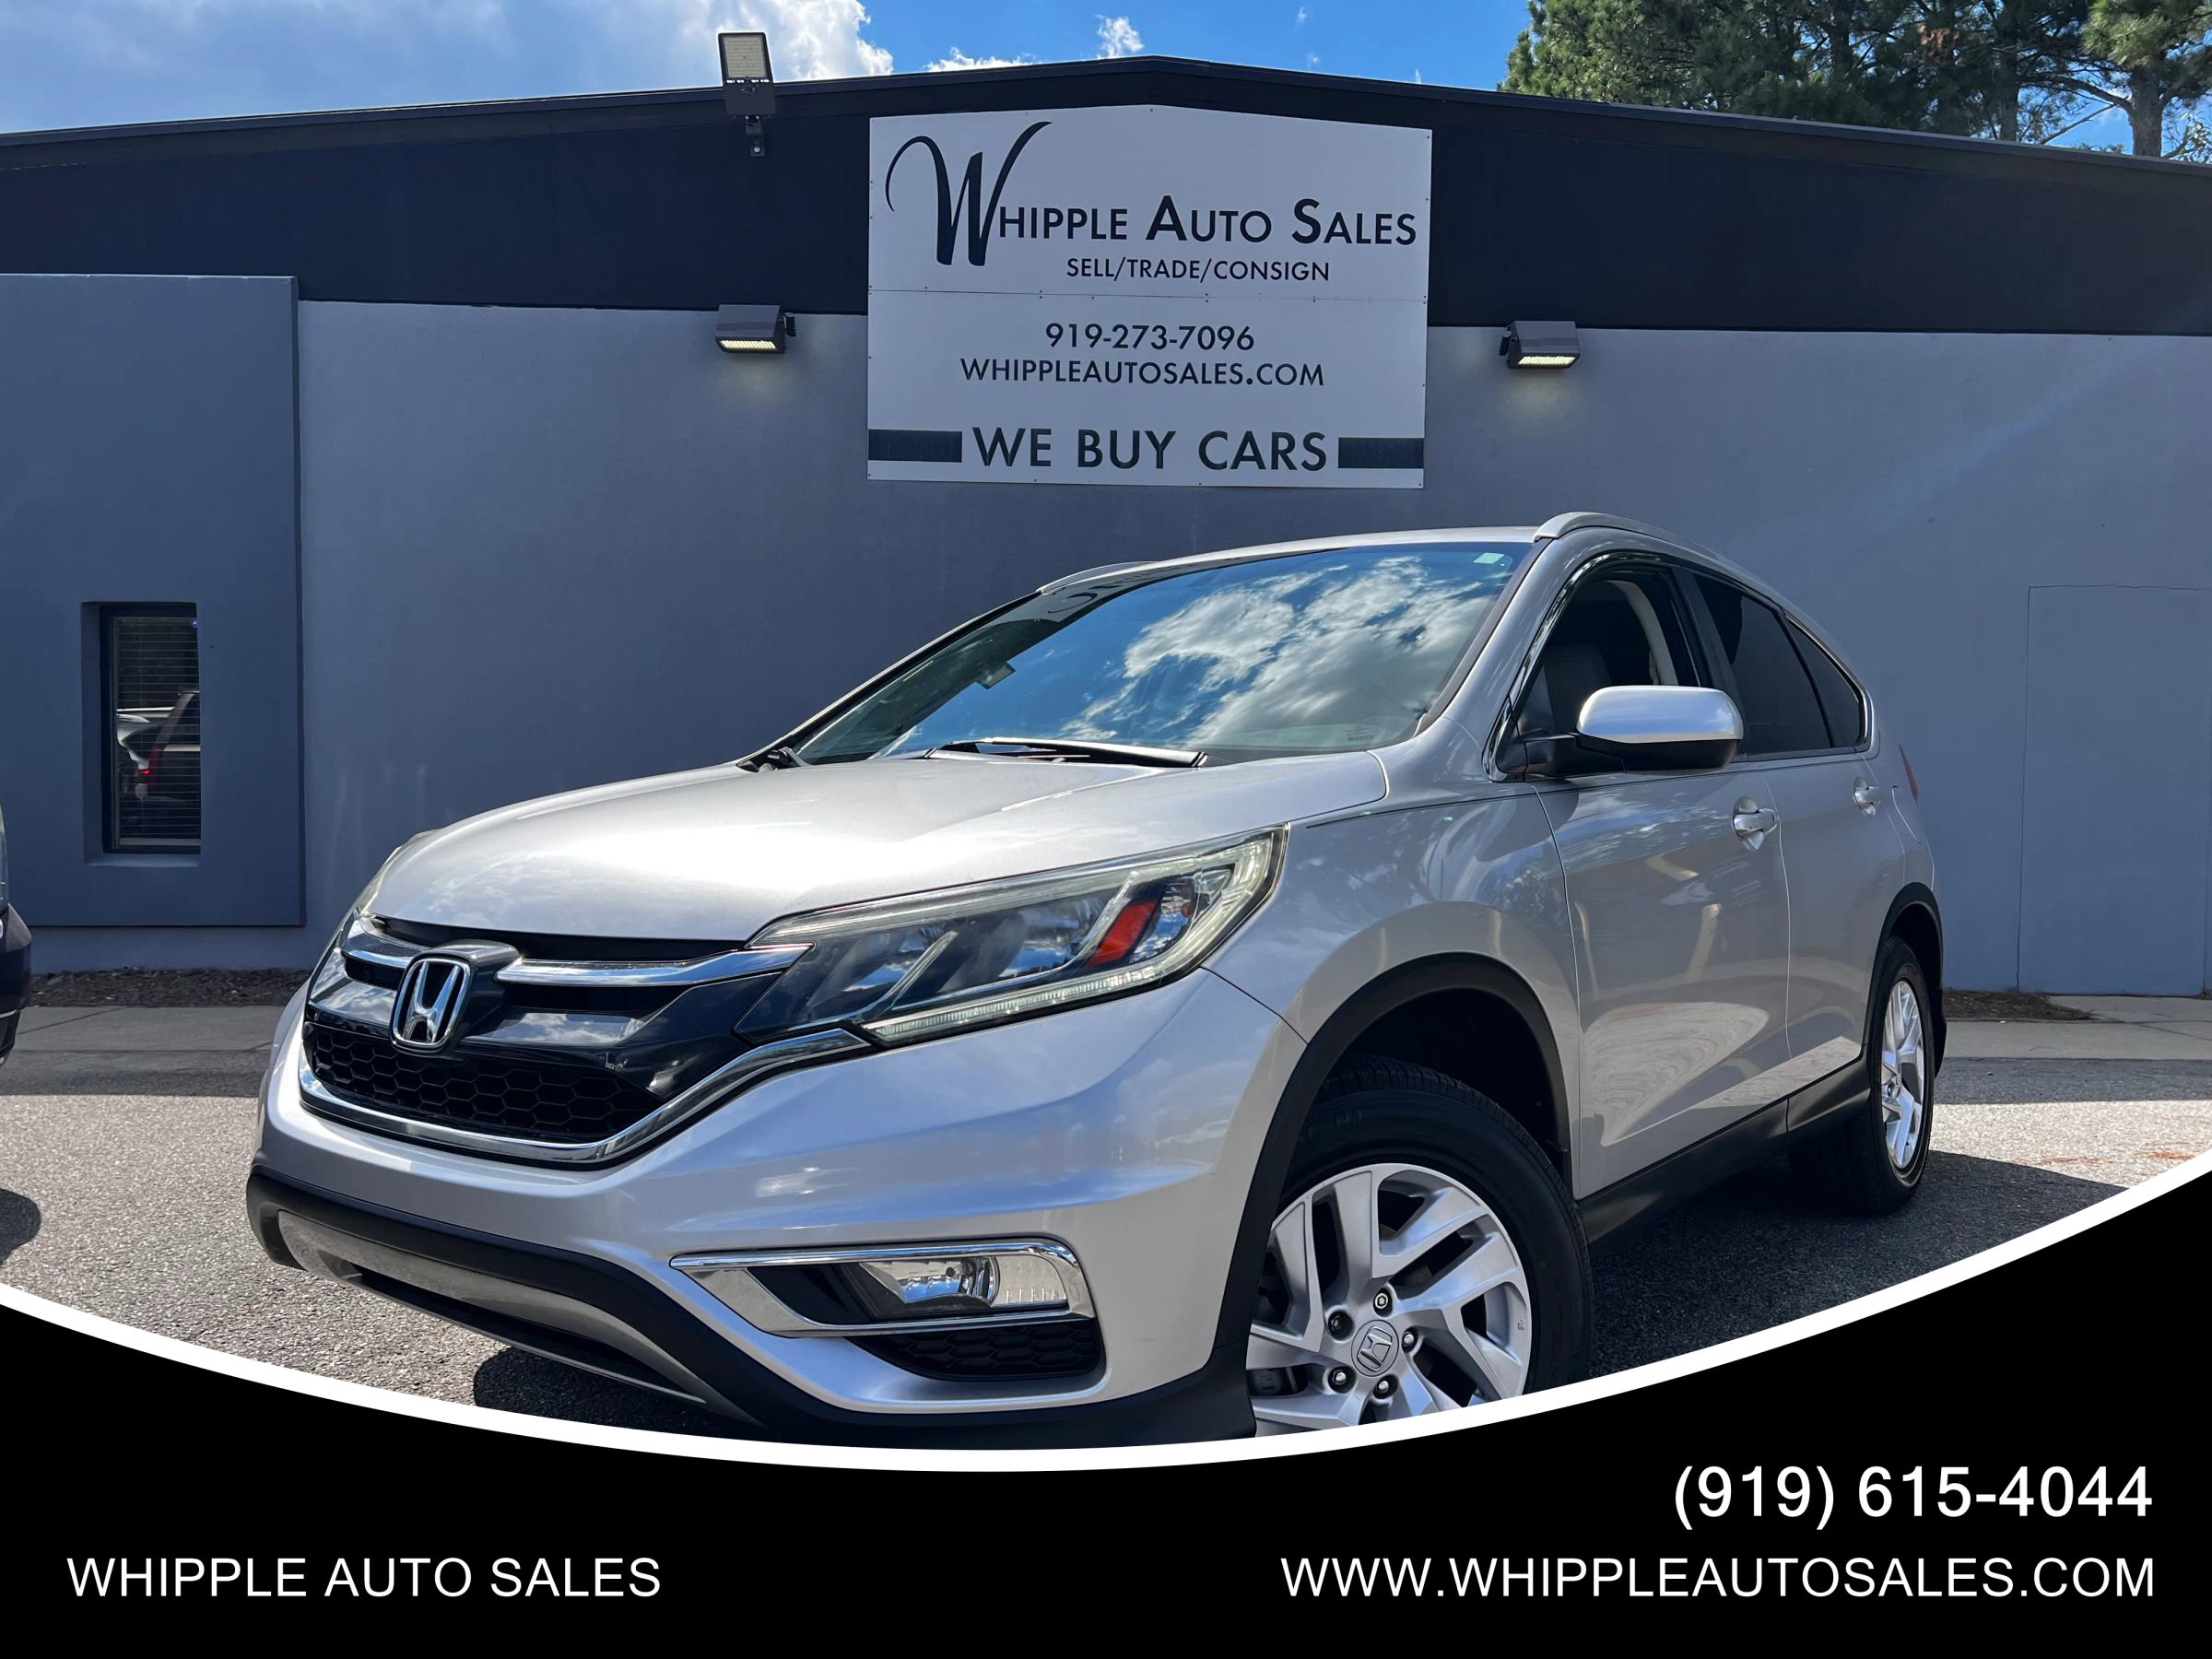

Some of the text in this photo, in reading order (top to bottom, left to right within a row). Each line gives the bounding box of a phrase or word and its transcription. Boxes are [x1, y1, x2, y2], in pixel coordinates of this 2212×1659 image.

[1066, 256, 1330, 283] SELL/TRADE/CONSIGN
[1045, 323, 1254, 351] 919-273-7096
[960, 358, 1324, 386] WHIPPLEAUTOSALES.COM
[972, 428, 1327, 472] WE BUY CARS
